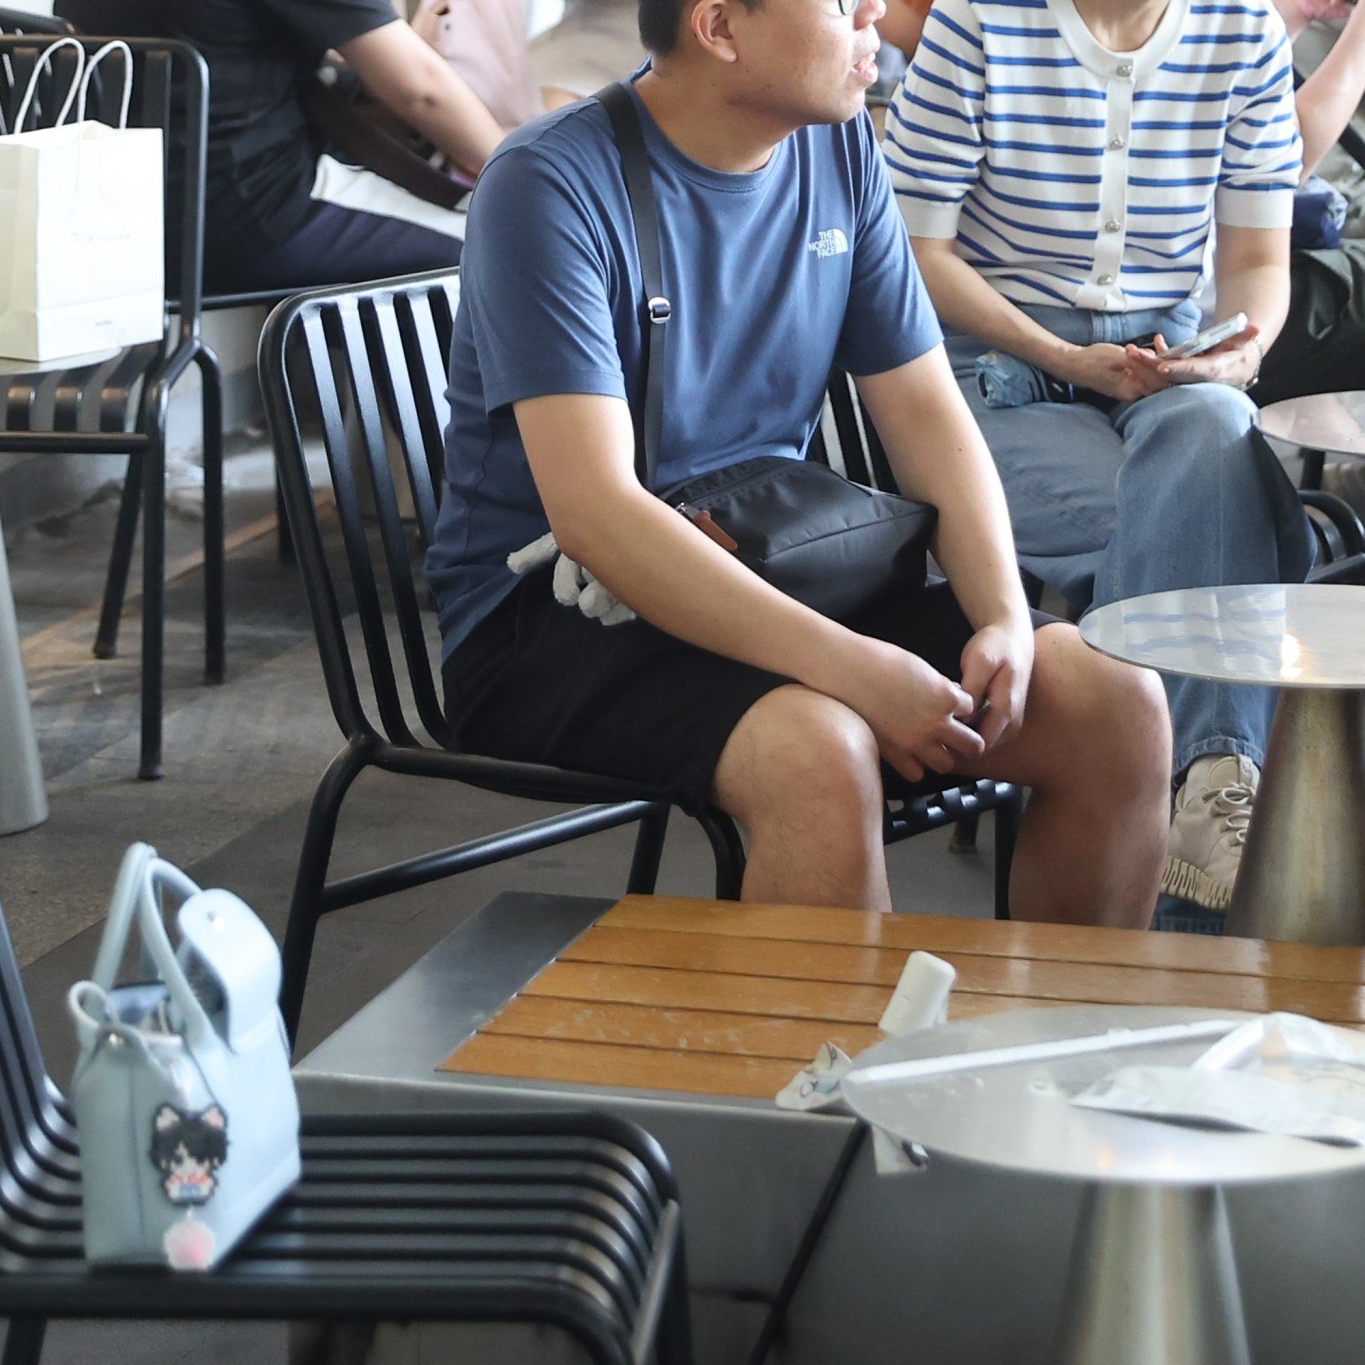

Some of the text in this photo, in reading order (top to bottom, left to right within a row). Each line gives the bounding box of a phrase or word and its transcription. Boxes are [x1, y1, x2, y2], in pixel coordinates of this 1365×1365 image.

[818, 229, 835, 241] THE
[807, 238, 836, 252] NORTH
[817, 247, 836, 259] FACE
